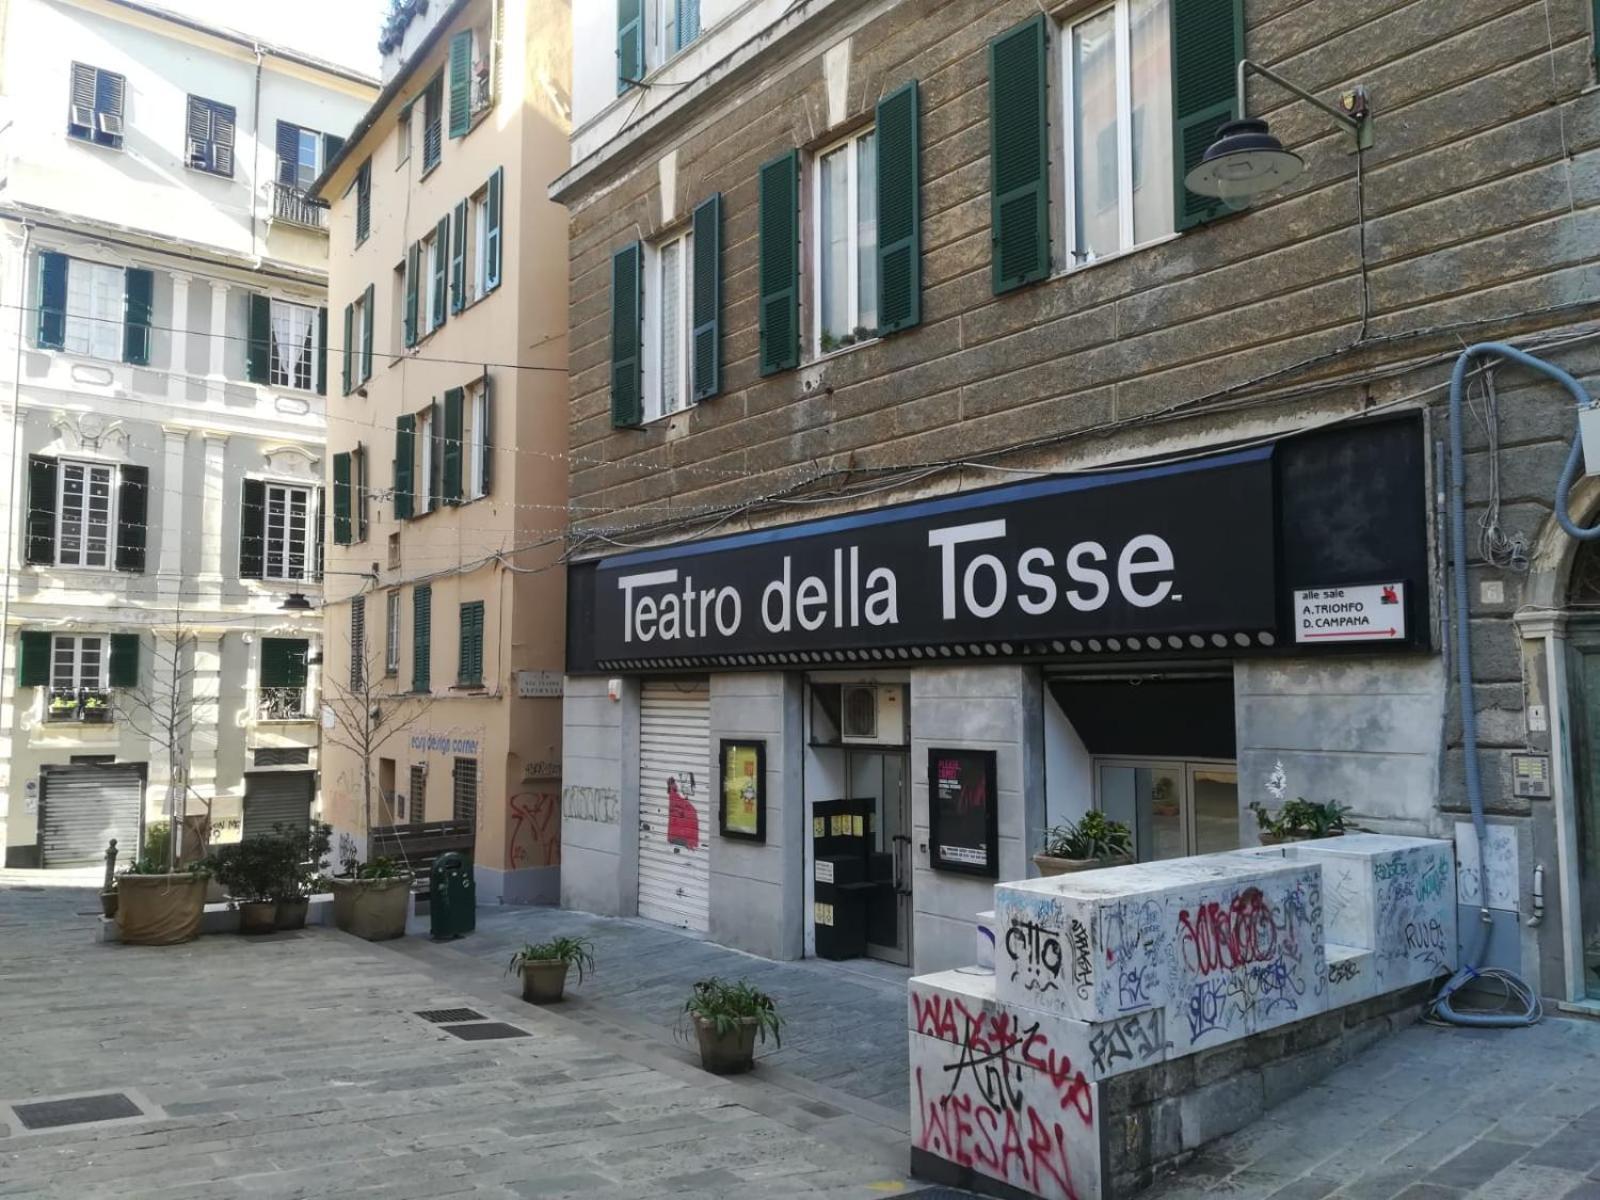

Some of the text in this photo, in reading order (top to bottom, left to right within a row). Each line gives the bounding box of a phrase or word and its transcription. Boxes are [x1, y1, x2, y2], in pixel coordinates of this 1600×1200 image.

[618, 569, 742, 642] Teatro
[761, 546, 899, 633] della
[1302, 589, 1344, 600] alle sale
